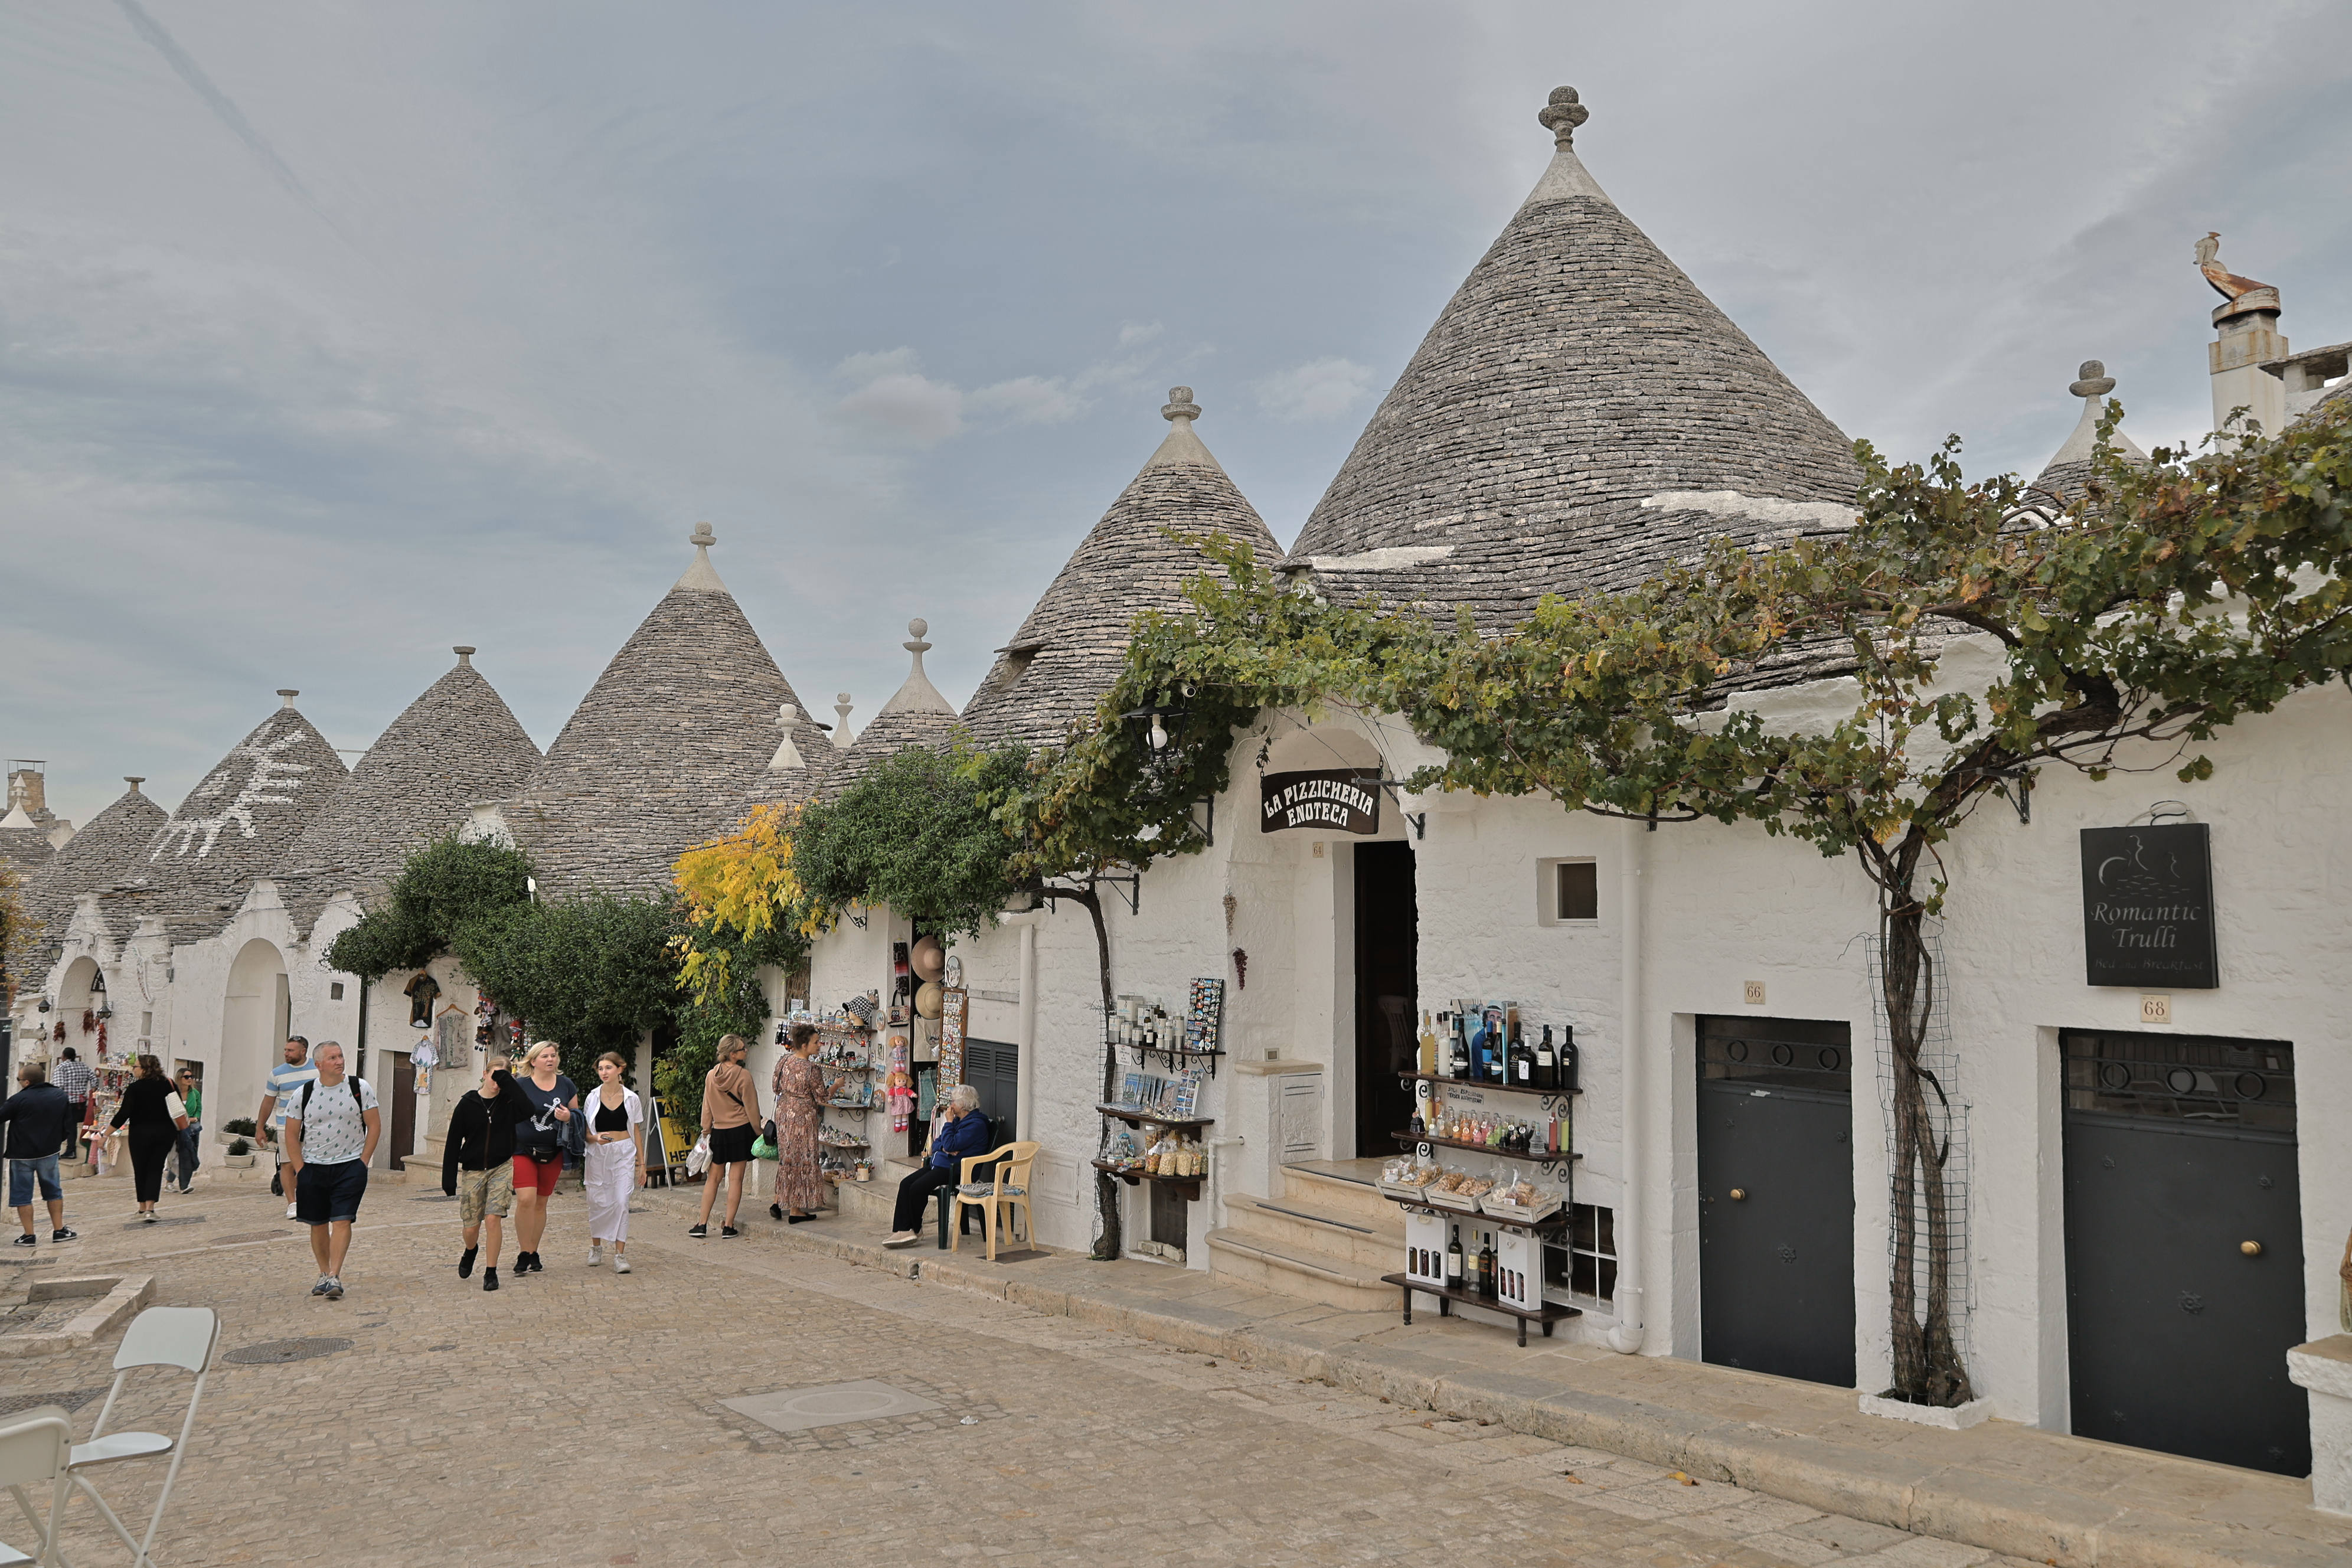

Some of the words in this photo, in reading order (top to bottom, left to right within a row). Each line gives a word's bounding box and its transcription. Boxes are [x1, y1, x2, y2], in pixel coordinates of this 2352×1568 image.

[1264, 794, 1282, 818] LA
[1283, 780, 1374, 816] PIZZICHERIA
[1286, 802, 1348, 827] ENOTECA
[1314, 846, 1322, 855] 64
[2090, 900, 2201, 925] Romantic
[2112, 925, 2177, 948] Trulli
[2143, 958, 2204, 973] Breakfast
[1747, 986, 1760, 998] 66
[2144, 1001, 2165, 1015] 68
